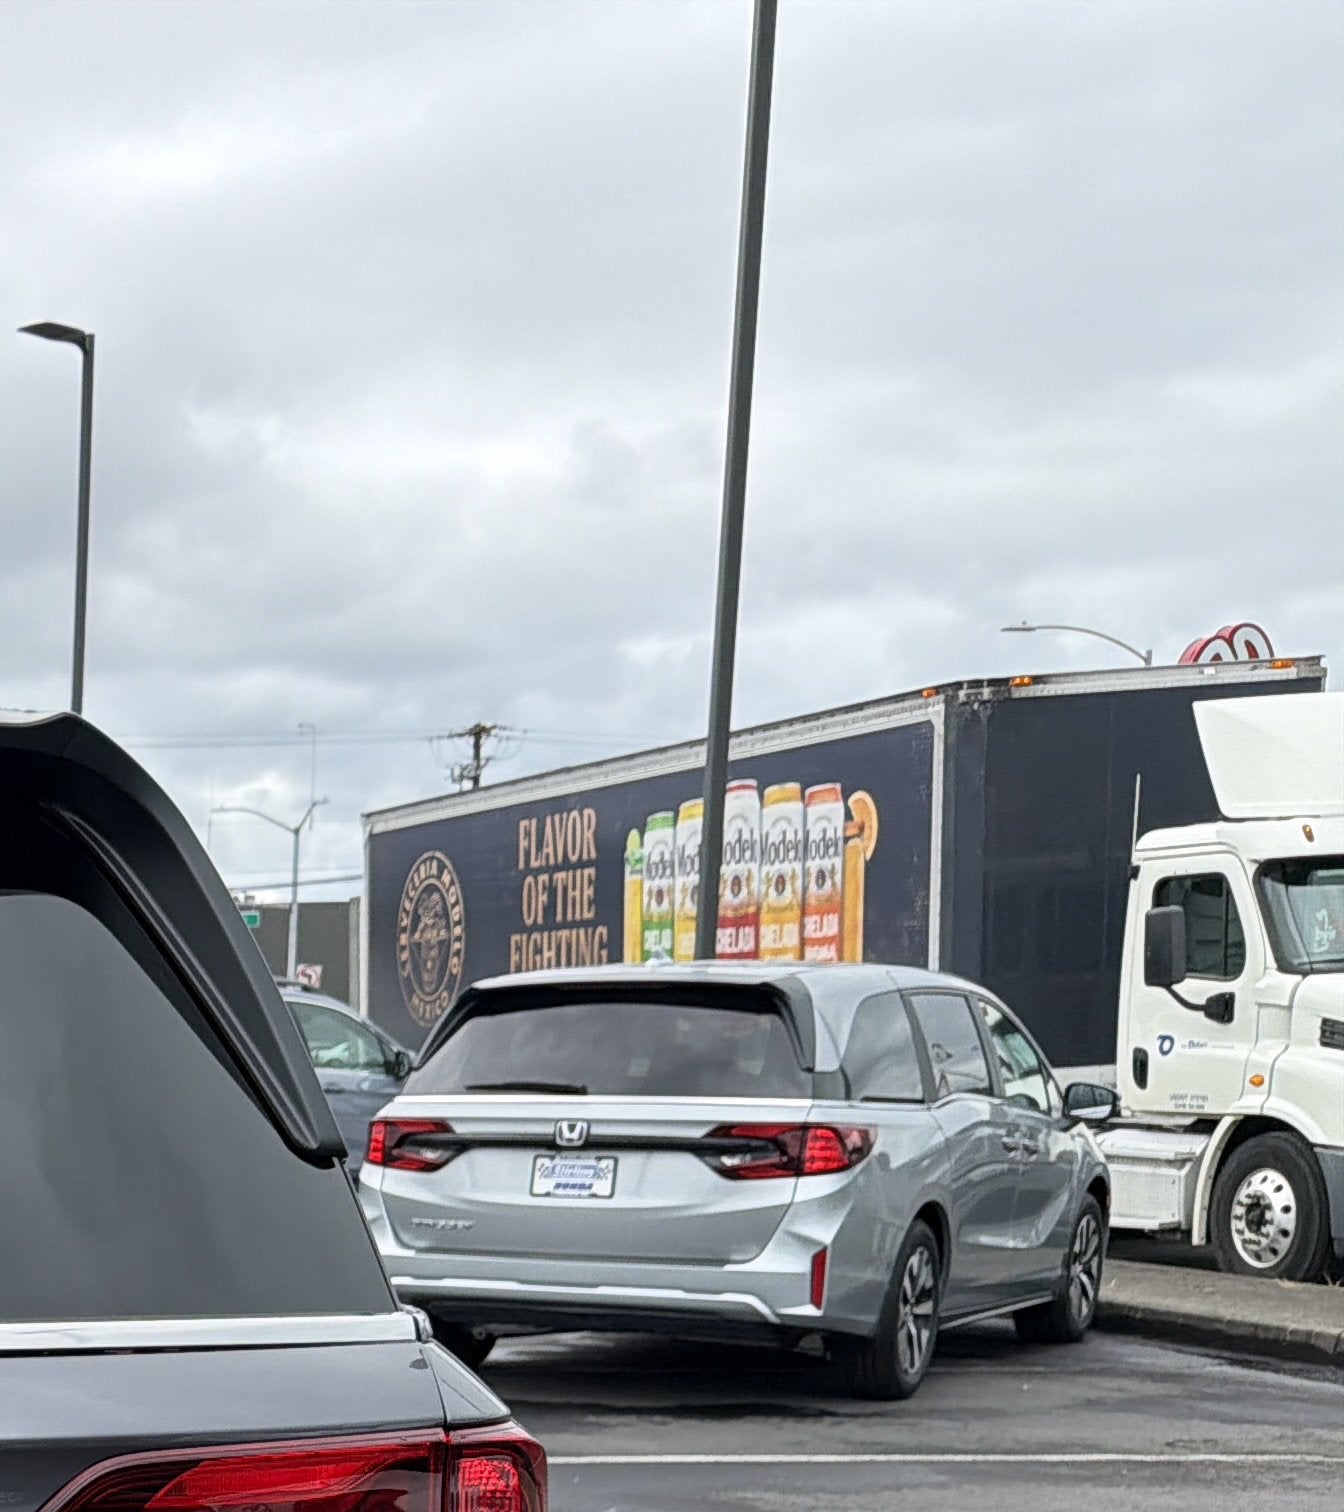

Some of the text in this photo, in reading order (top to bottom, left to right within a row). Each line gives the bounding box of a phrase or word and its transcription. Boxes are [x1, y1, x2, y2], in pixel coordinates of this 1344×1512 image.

[518, 808, 597, 870] FLAVOR
[722, 827, 758, 866] odel
[522, 867, 596, 926] OF THE
[510, 925, 608, 974] FIGHTING
